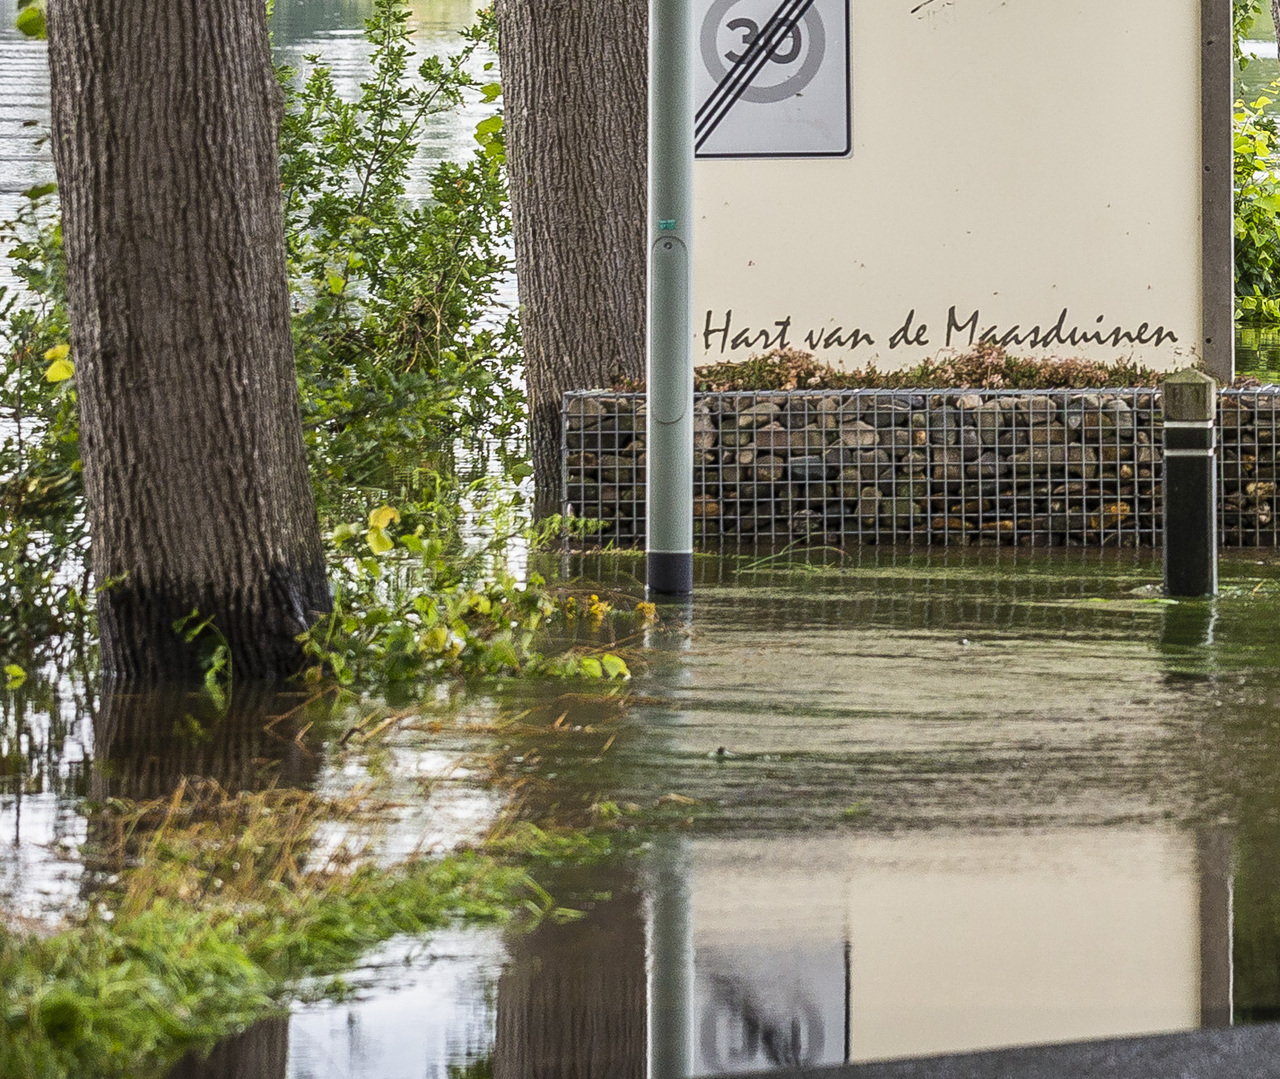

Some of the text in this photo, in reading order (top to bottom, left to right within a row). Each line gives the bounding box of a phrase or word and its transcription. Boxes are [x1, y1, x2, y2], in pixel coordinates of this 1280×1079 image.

[724, 17, 802, 65] 30
[703, 305, 1179, 351] Hart van de Maasduinen
